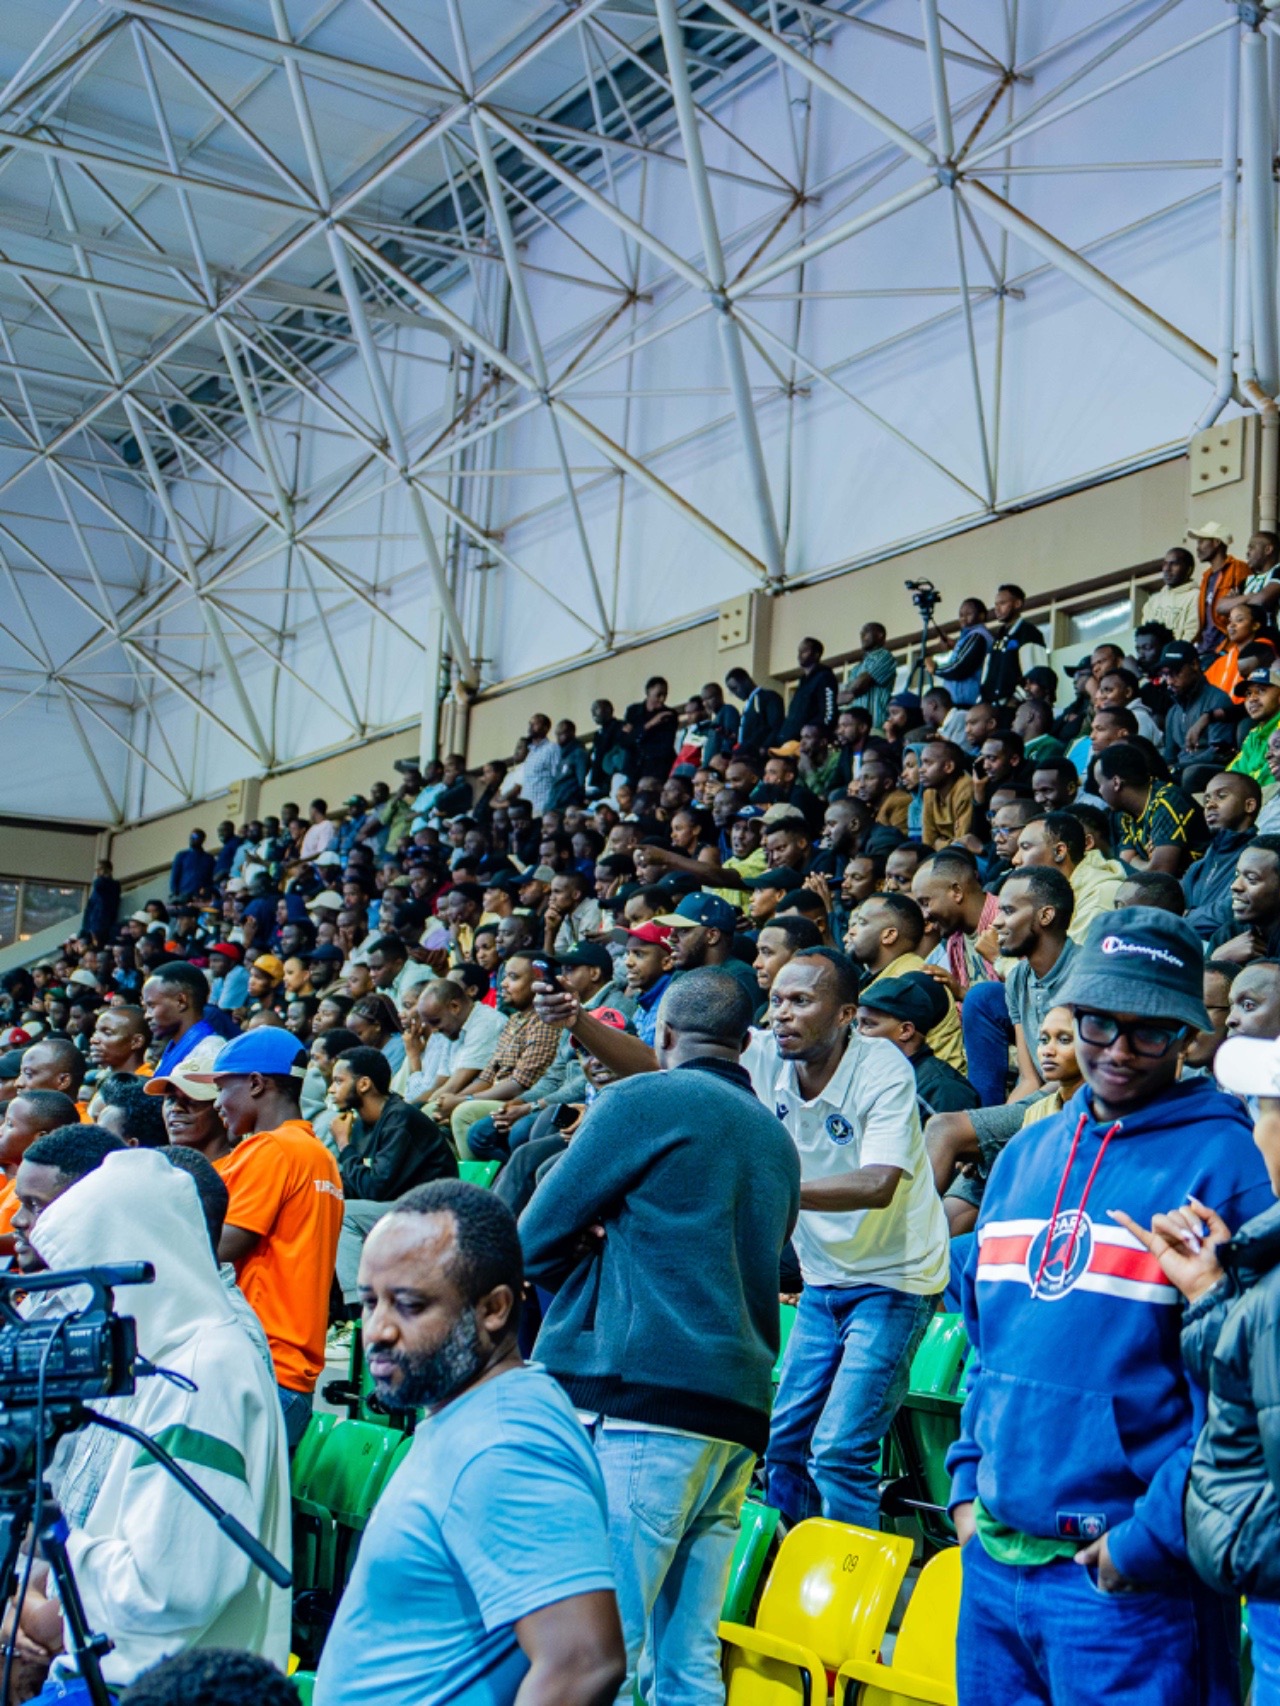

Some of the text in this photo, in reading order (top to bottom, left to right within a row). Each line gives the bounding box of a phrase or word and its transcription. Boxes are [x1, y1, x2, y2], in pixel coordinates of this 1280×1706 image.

[1102, 936, 1184, 967] Champion
[1052, 1213, 1088, 1240] PARS
[70, 1346, 90, 1356] 4K
[842, 1553, 859, 1573] 09
